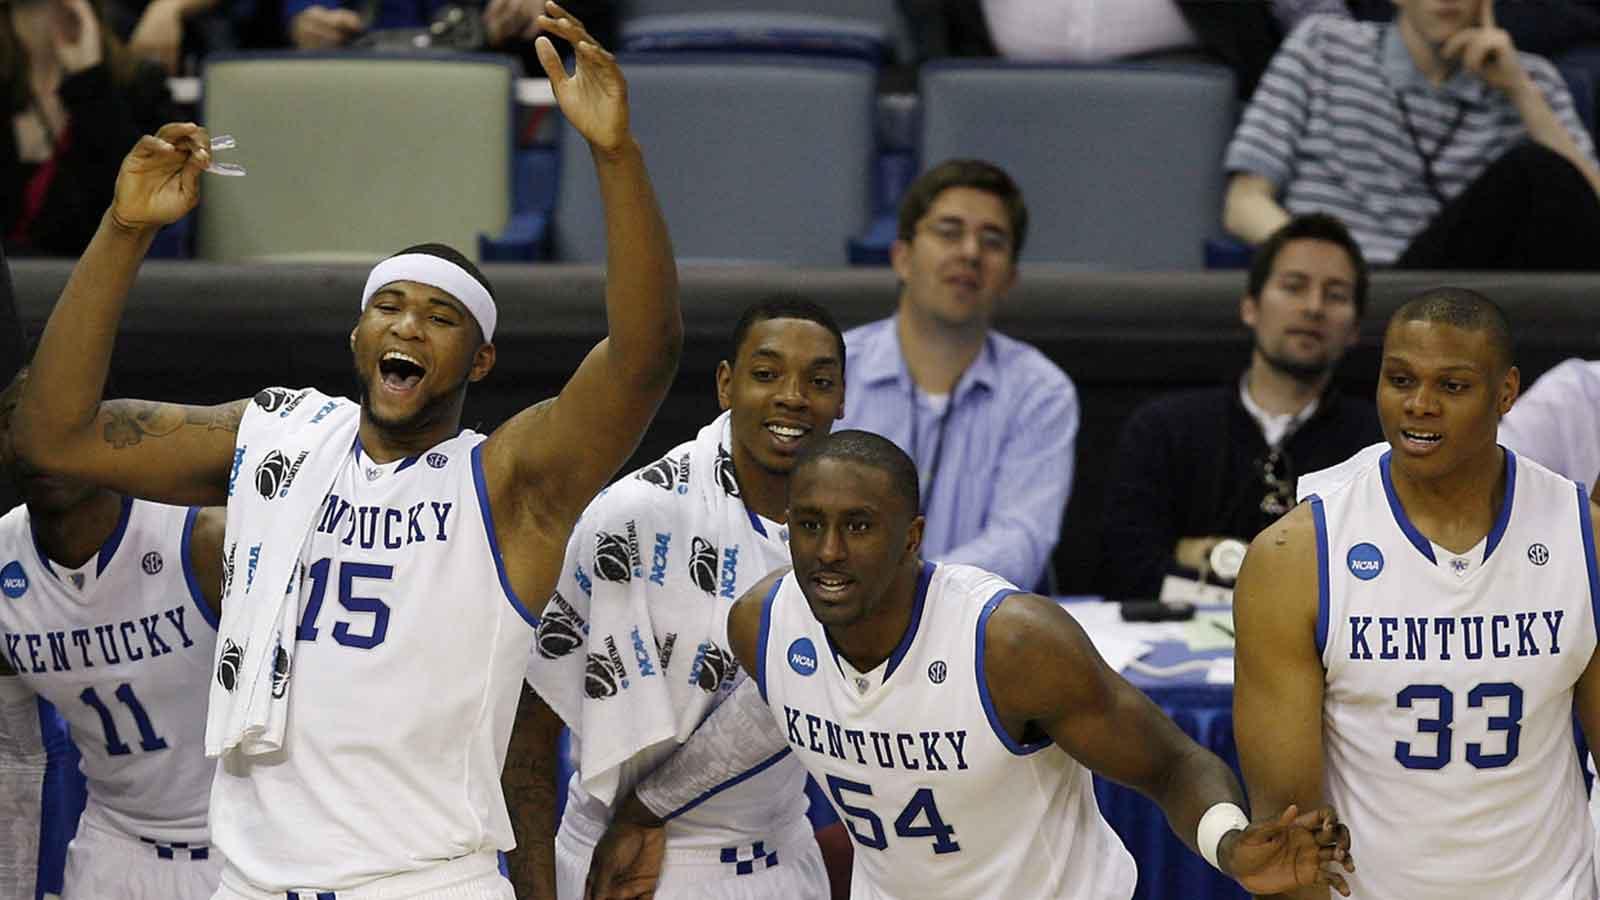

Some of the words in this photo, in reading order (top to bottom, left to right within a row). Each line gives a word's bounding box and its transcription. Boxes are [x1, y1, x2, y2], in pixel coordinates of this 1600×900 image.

[427, 453, 449, 469] SEC
[316, 494, 452, 549] NUCKY
[142, 552, 163, 575] SEC
[649, 532, 671, 587] NCAA
[720, 544, 738, 599] NCAA
[1351, 559, 1379, 571] NCAA
[1528, 543, 1549, 566] SEC
[3, 578, 26, 588] NCAA
[296, 557, 394, 650] 15
[5, 606, 194, 675] KENTUCKY
[791, 653, 815, 669] NCAA
[1349, 611, 1564, 661] KENTUCKY
[79, 683, 169, 757] 11
[783, 705, 968, 770] KENTUCKY
[1394, 682, 1524, 770] 33
[825, 773, 961, 854] 54
